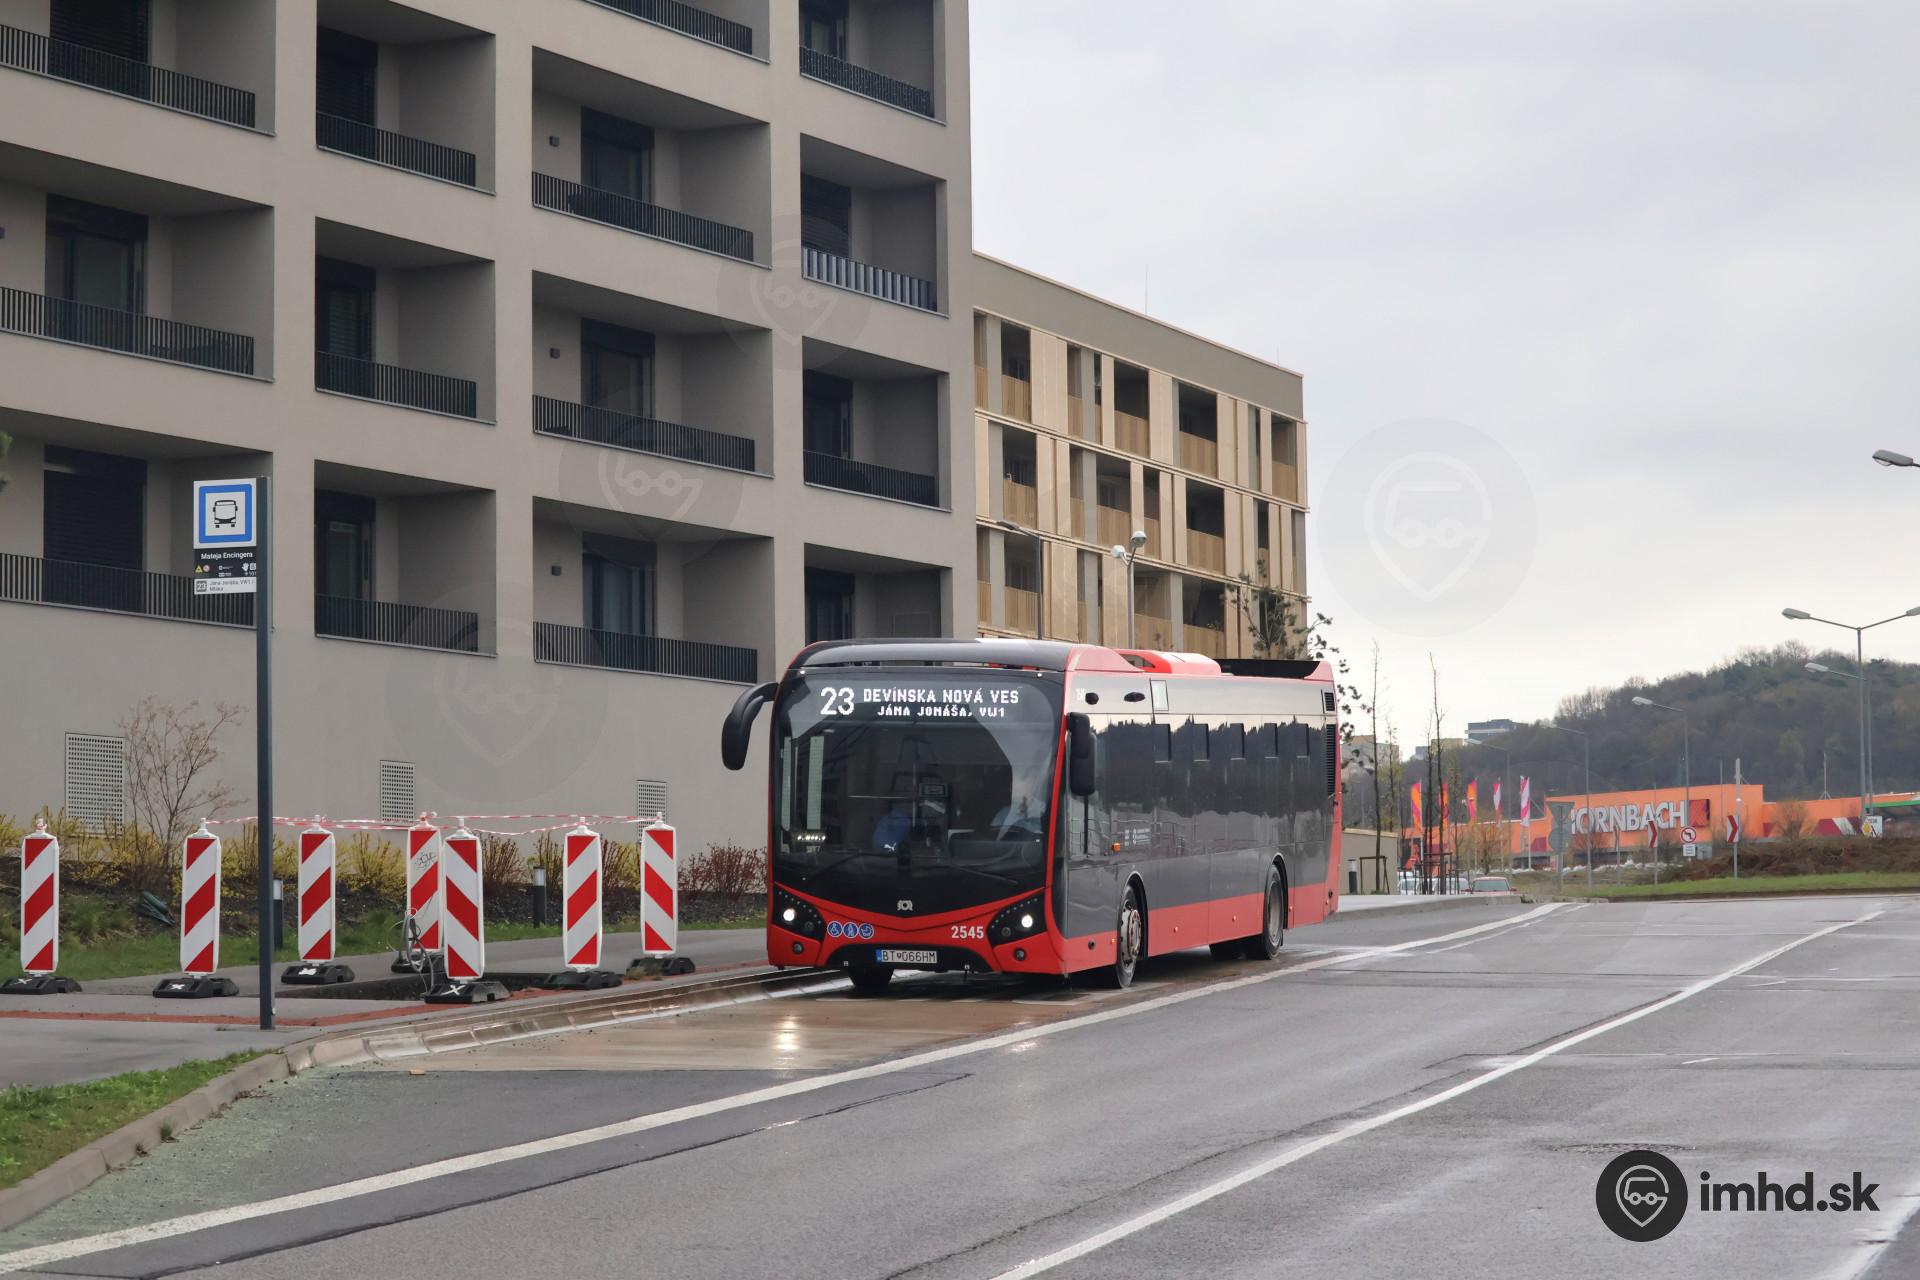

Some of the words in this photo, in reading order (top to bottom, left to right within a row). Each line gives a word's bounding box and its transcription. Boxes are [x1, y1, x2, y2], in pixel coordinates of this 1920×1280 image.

[223, 552, 253, 560] Encingera
[820, 687, 855, 716] 23
[864, 687, 936, 704] DEVÍNSKA
[943, 688, 984, 704] NOVÁ
[990, 690, 1019, 704] VES
[979, 707, 1005, 717] VW1
[951, 925, 984, 940] 2545
